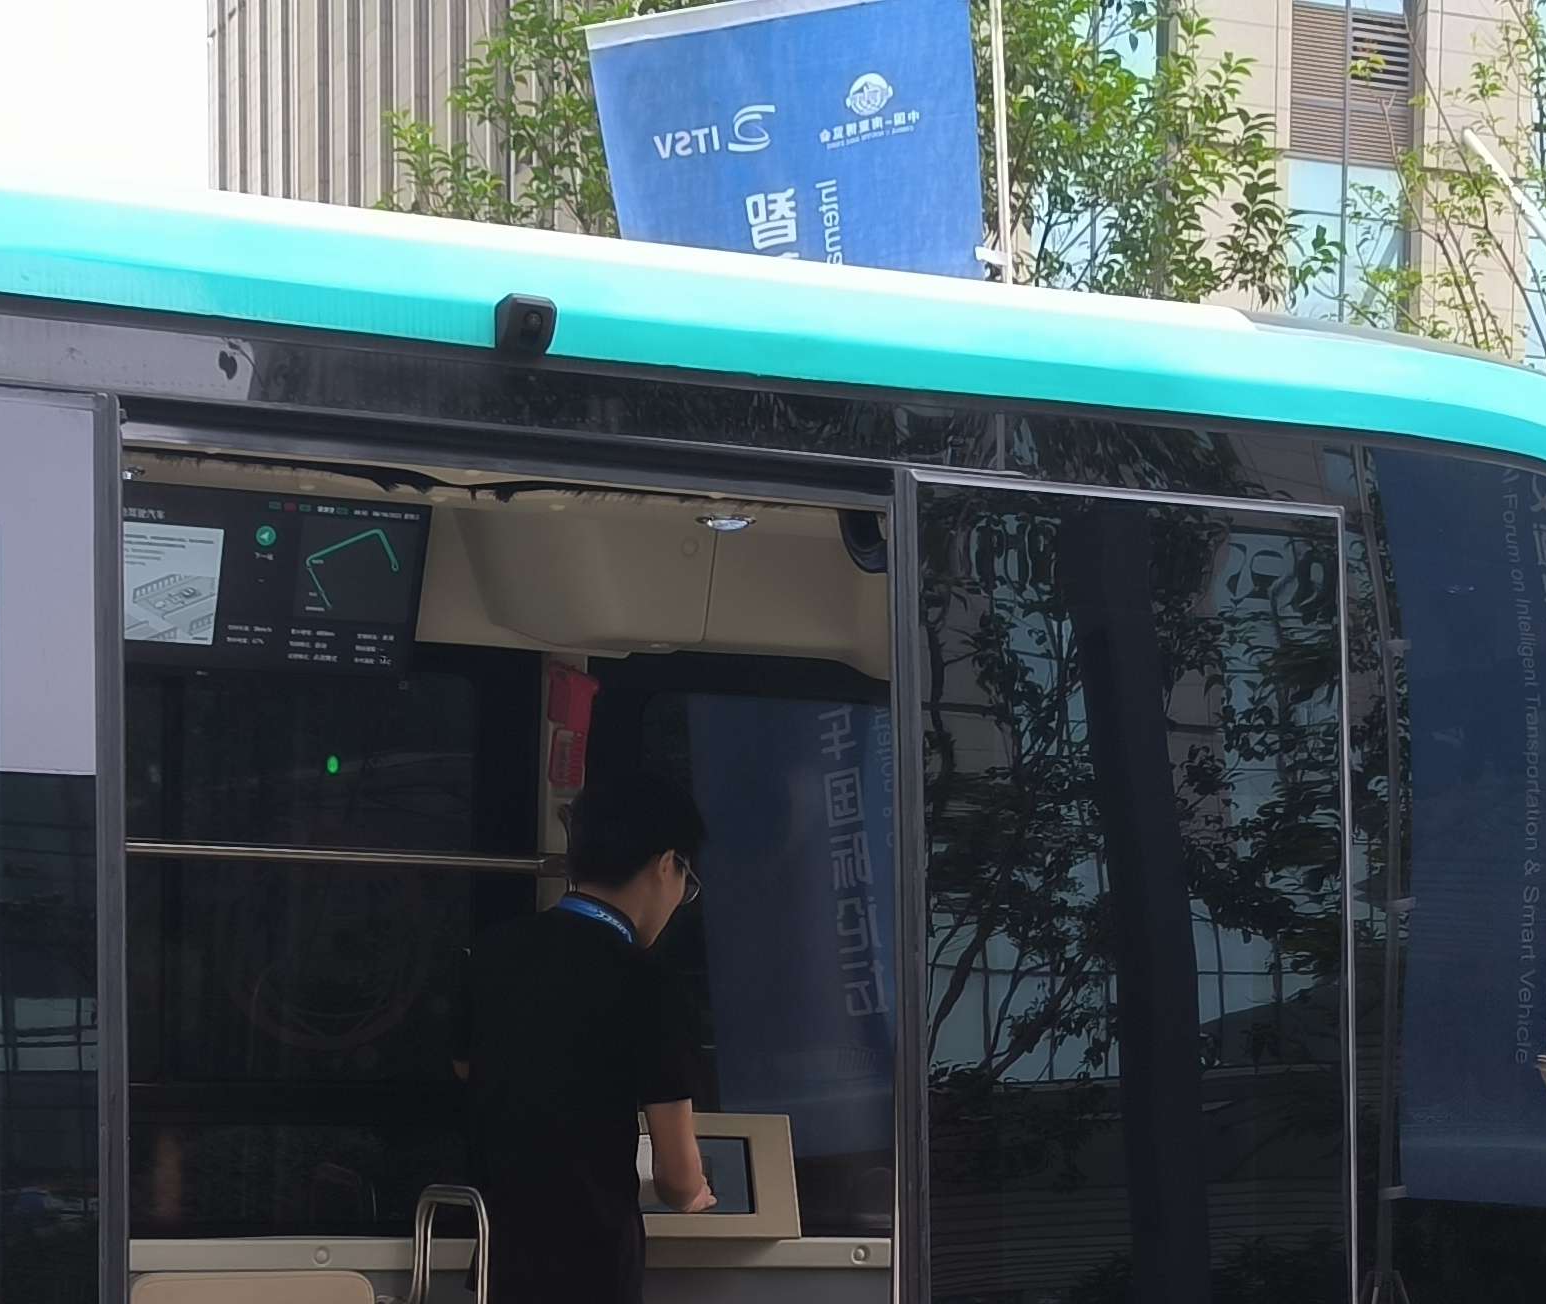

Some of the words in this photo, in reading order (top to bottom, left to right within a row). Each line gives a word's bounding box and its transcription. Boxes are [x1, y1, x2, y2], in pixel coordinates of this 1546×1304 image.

[1503, 494, 1521, 563] Forum
[1510, 568, 1525, 592] on
[1516, 598, 1540, 687] Intelligent
[1522, 693, 1541, 850] Transportation
[1520, 885, 1540, 961] Smart
[1515, 968, 1536, 1065] Vehicle
